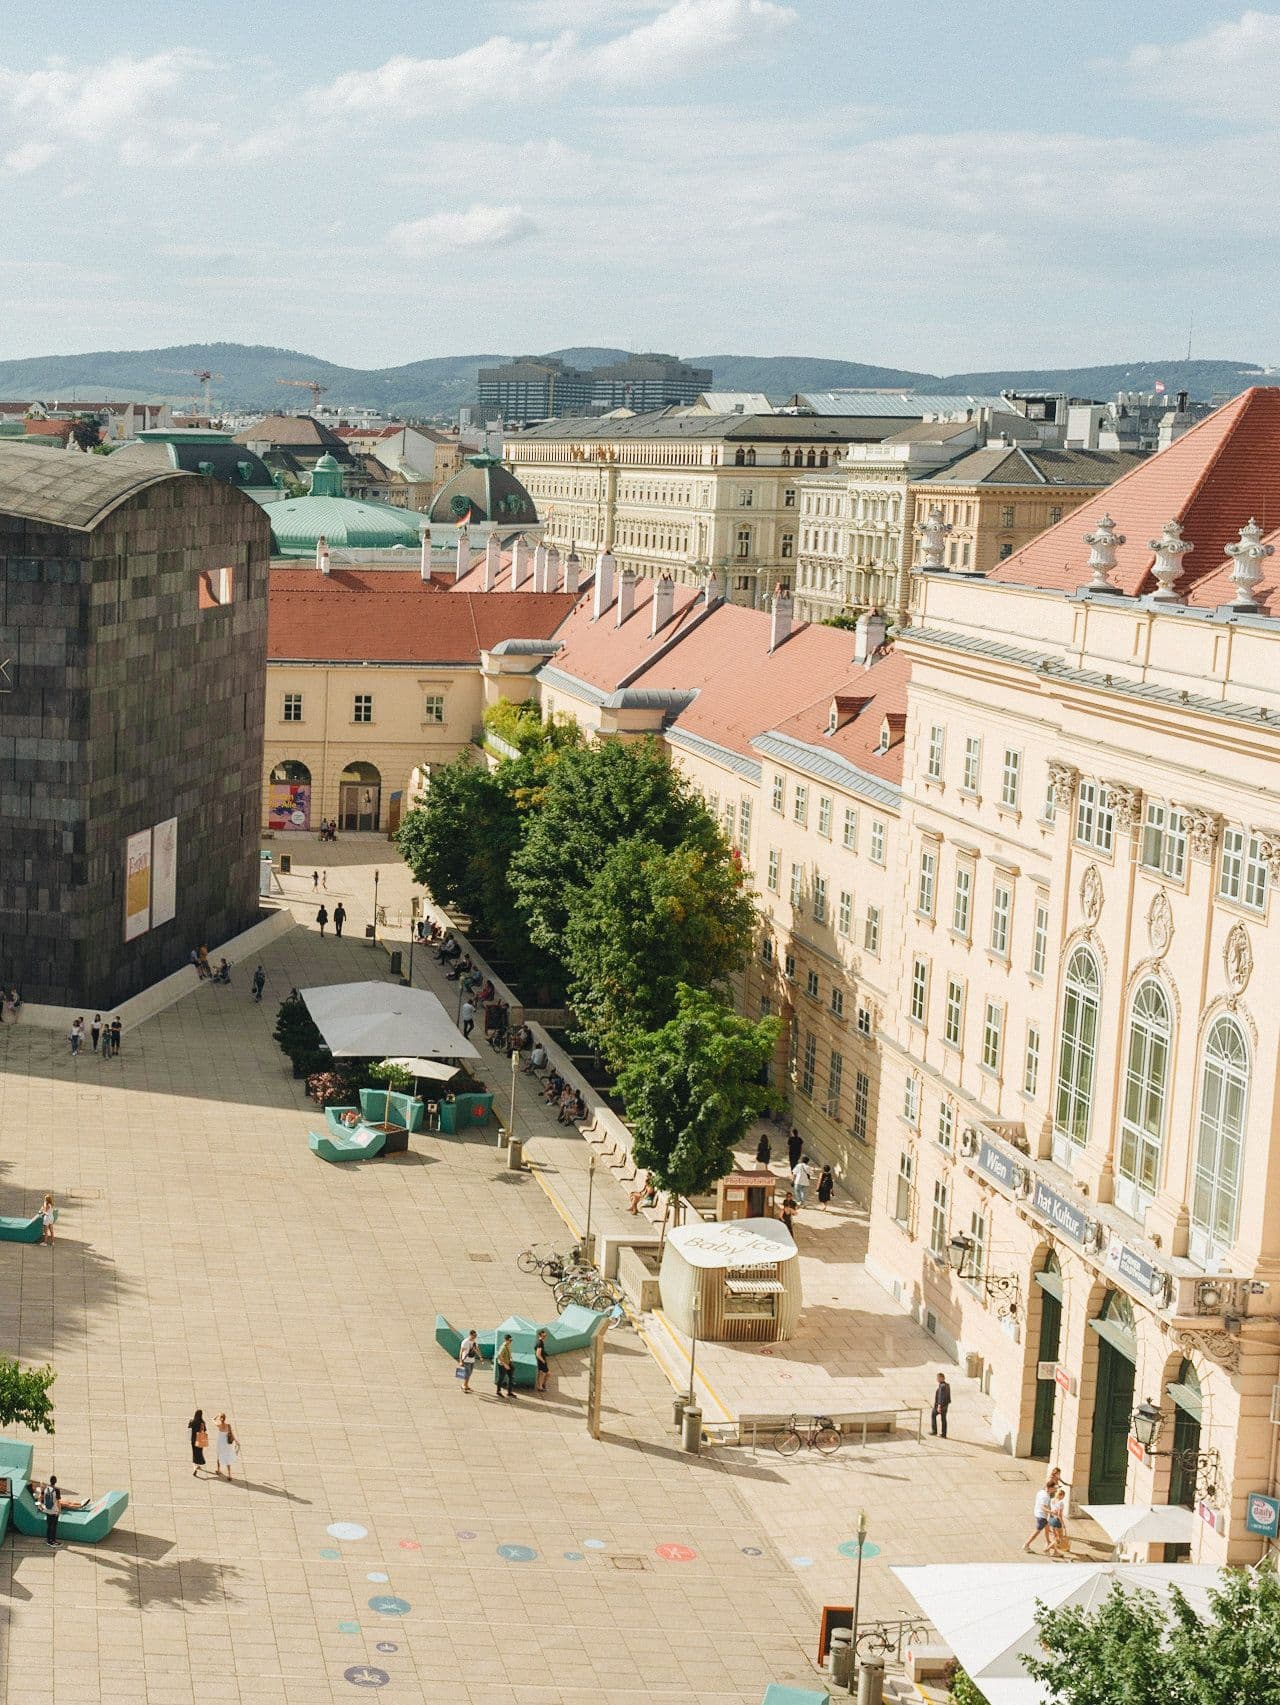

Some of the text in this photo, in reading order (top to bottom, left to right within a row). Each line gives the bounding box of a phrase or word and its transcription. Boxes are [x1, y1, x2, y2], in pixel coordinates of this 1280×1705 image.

[986, 1149, 1007, 1180] Wien
[1037, 1187, 1080, 1236] hat Kultur.
[684, 1236, 745, 1256] Baby
[720, 1225, 780, 1252] Ice Ice
